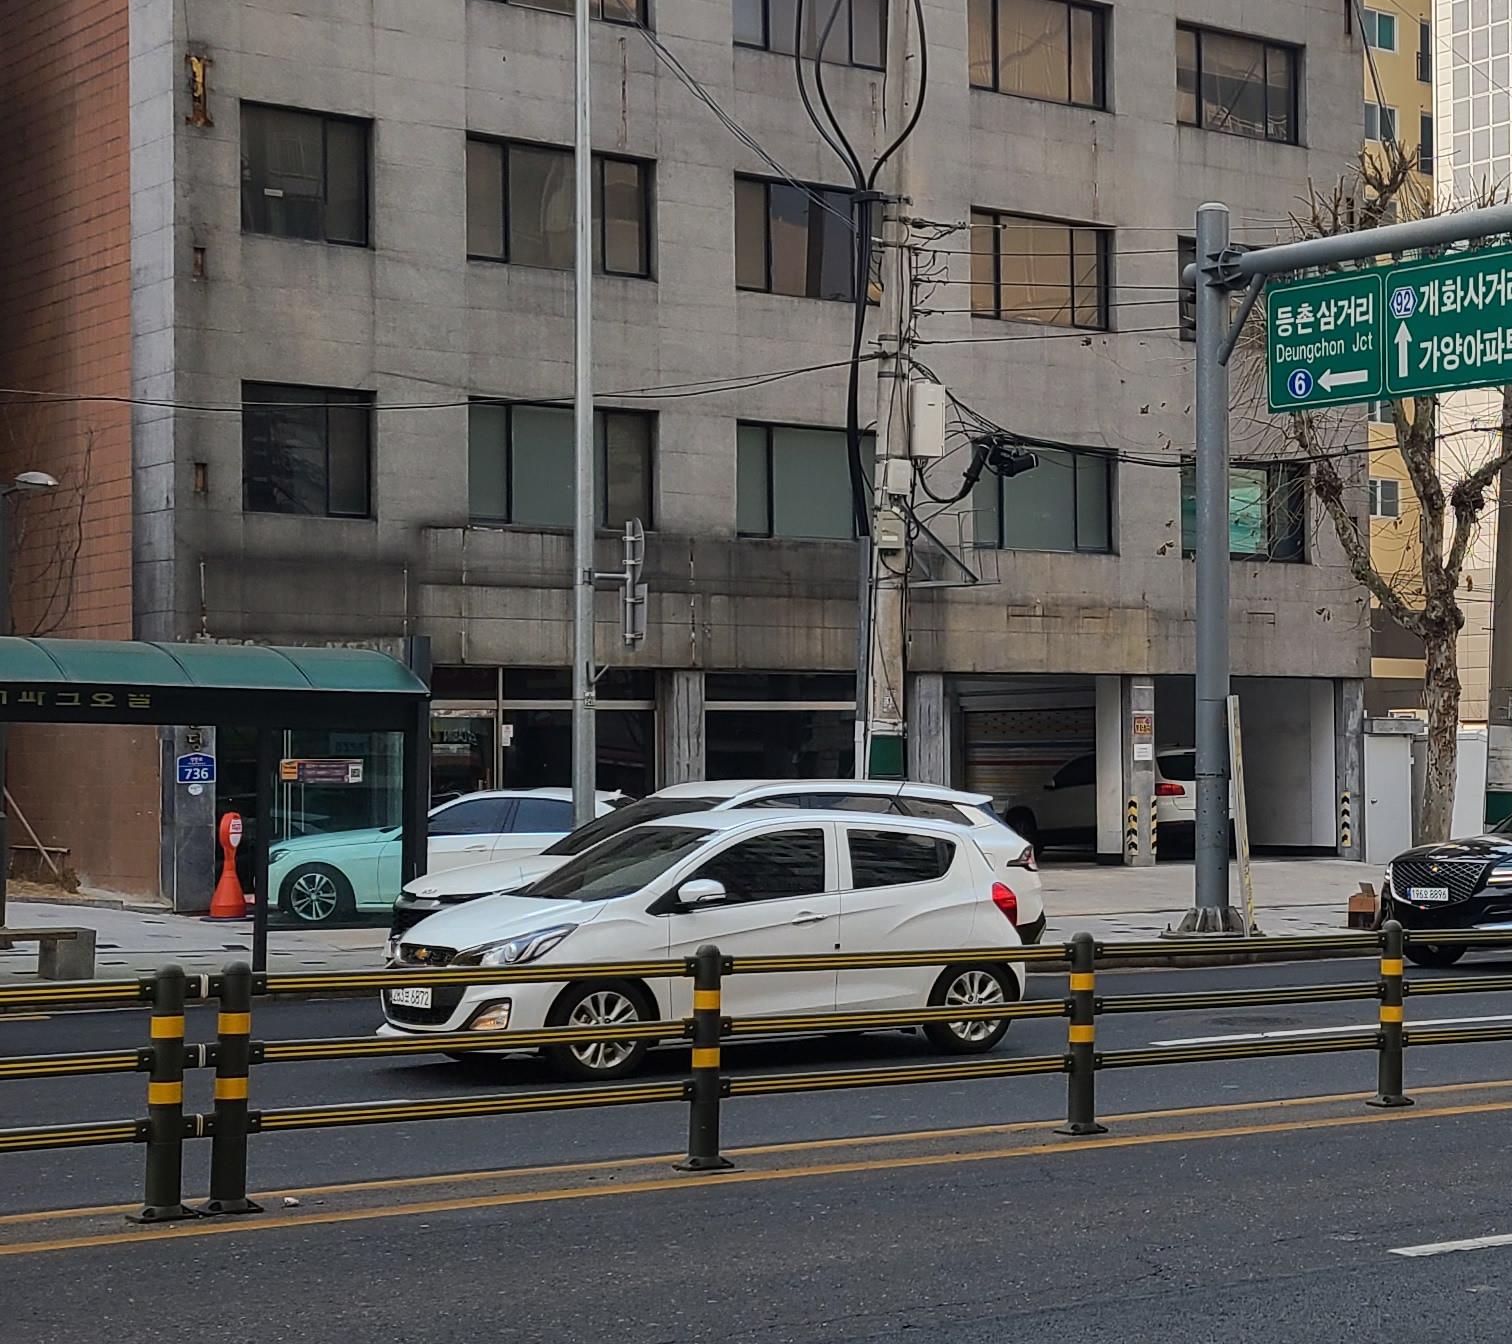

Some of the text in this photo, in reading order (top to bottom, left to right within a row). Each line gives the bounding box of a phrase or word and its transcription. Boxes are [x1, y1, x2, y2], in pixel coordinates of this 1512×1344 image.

[1395, 290, 1411, 313] 92
[1276, 293, 1373, 336] 등촌삼거리
[1276, 332, 1373, 363] Deungchon Jct
[1294, 372, 1306, 395] 6
[184, 767, 209, 780] 736
